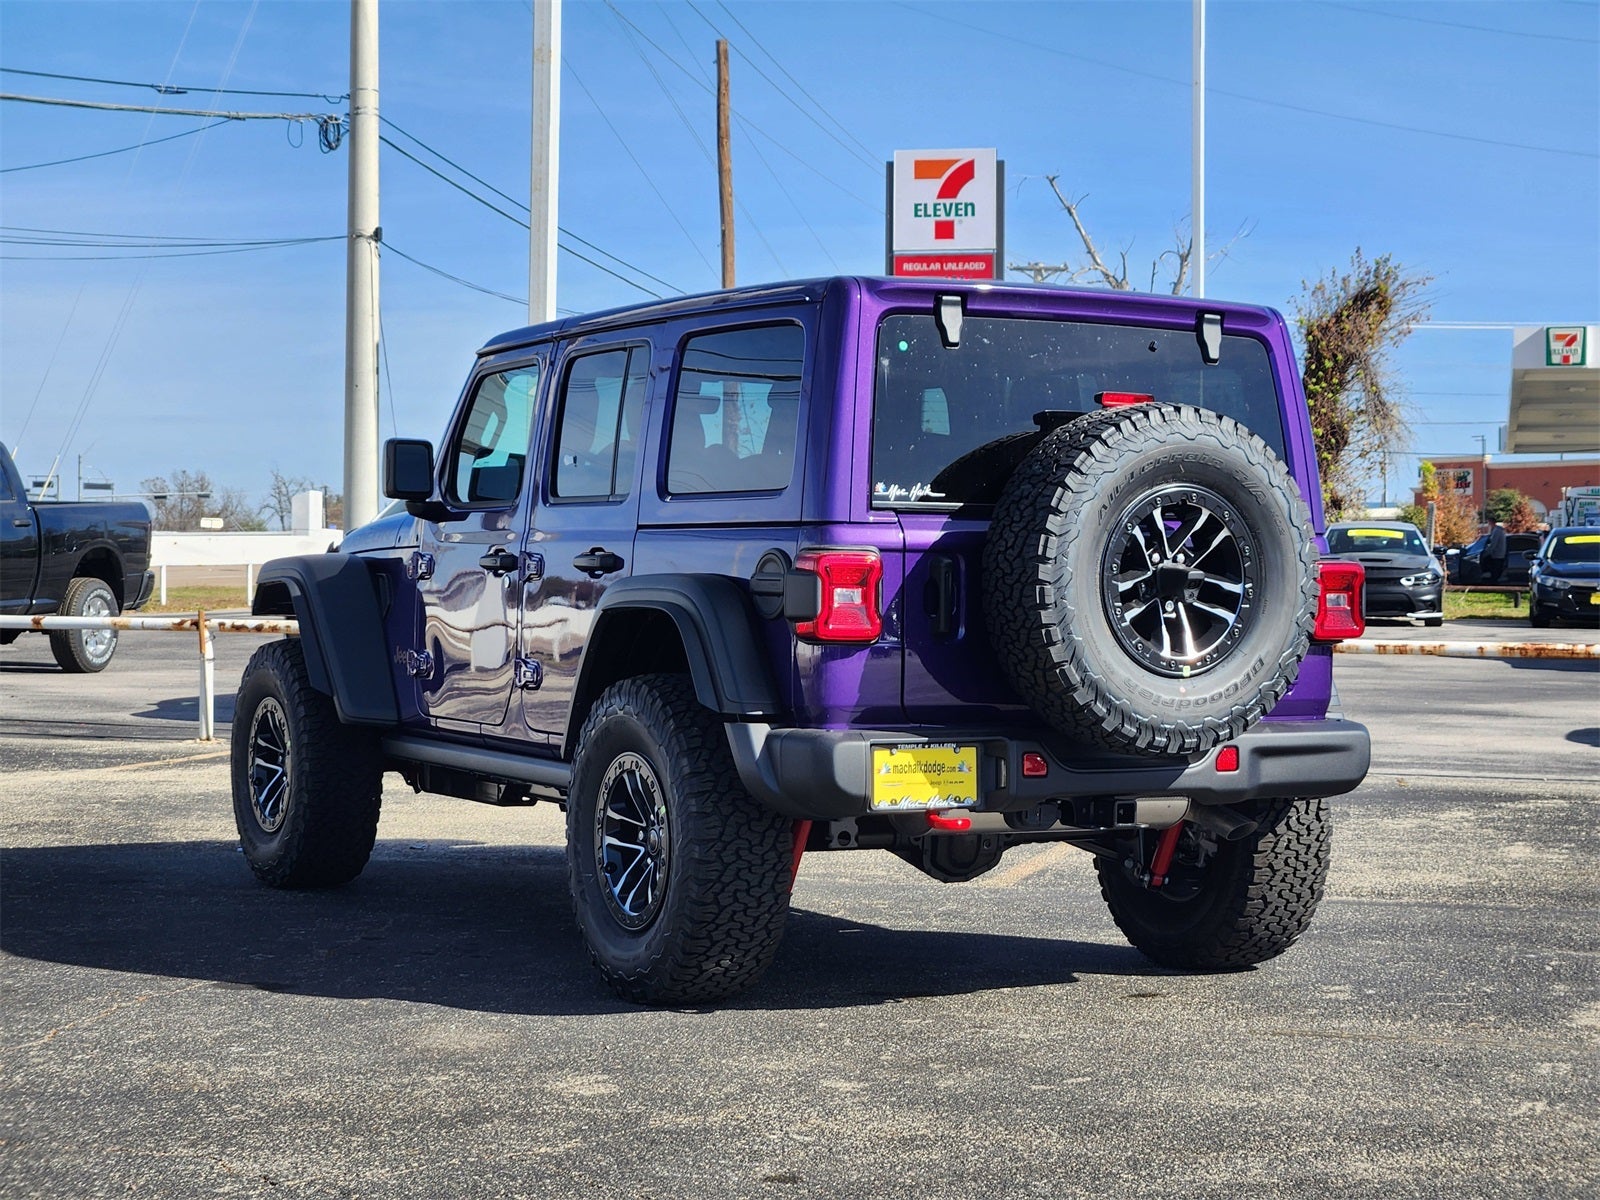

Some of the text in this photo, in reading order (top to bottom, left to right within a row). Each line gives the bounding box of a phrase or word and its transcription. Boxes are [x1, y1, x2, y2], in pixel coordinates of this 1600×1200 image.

[903, 262, 985, 271] REGULAR UNLEADED
[887, 482, 938, 501] Mac Haik
[1123, 655, 1265, 711] BFGoodrich
